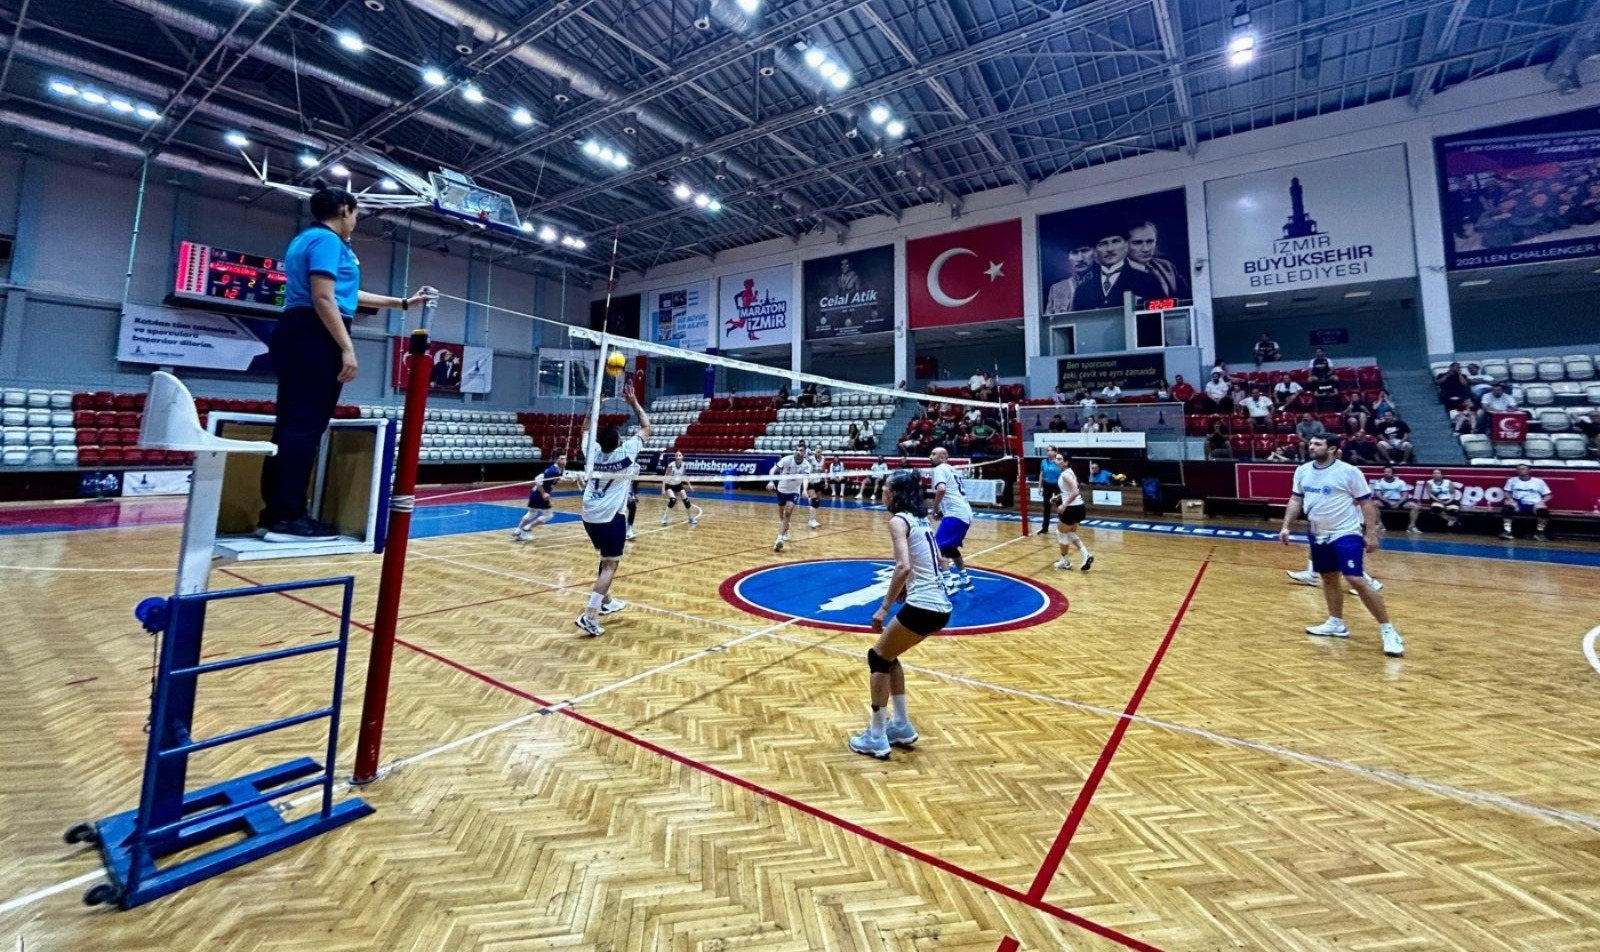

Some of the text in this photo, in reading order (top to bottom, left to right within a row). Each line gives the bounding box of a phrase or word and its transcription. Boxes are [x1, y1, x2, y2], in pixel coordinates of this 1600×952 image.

[1272, 235, 1331, 255] İZMİR
[1244, 244, 1374, 275] BÜYÜKŞEHİR
[1455, 243, 1596, 266] 2023 LEN CHALLENGER
[1250, 261, 1368, 288] BELEDİYESİ
[247, 279, 256, 288] 2
[225, 288, 238, 299] 12
[819, 293, 849, 308] Celal
[850, 289, 878, 304] Atik
[740, 301, 787, 318] MARATON
[147, 327, 199, 339] sporculara
[172, 321, 191, 330] tüm
[1079, 370, 1097, 379] çevik
[1125, 367, 1157, 377] zamanda
